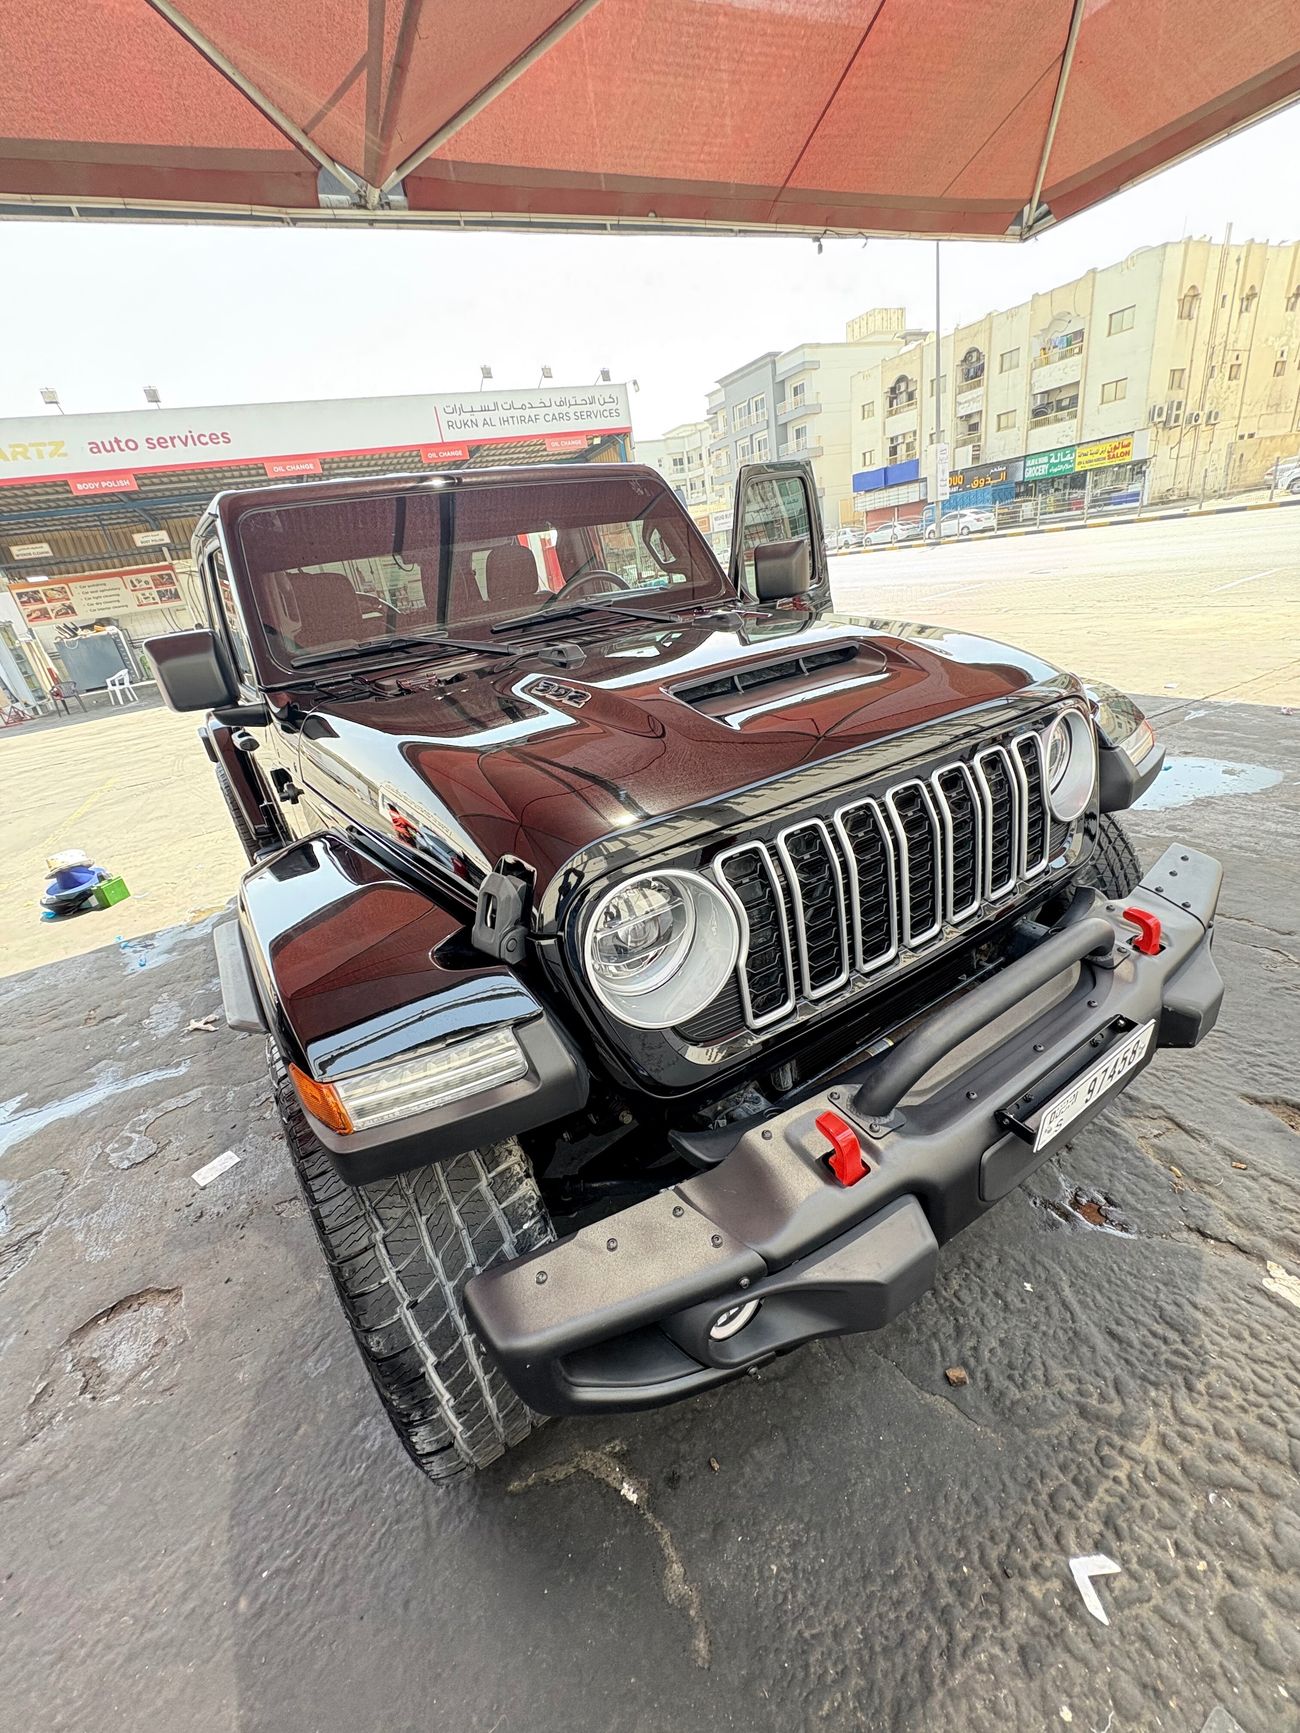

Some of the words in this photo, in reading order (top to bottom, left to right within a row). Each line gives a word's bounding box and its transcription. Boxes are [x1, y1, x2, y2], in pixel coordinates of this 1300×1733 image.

[501, 398, 553, 411] لخدمات
[554, 395, 596, 408] الاحتراف
[597, 393, 619, 406] ركن
[443, 401, 499, 416] السيارات
[446, 418, 479, 431] RUKN
[482, 417, 496, 428] AL
[498, 413, 540, 427] IHTIRAF
[543, 411, 571, 424] CARS
[573, 408, 621, 420] SERVICES
[87, 436, 139, 454] auto
[145, 430, 232, 450] services
[439, 450, 463, 458] CHANGE
[1107, 450, 1131, 460] SALON
[286, 463, 314, 471] CHANGE
[1025, 464, 1049, 478] GROCERY
[76, 482, 99, 490] BODY
[101, 480, 130, 488] POLISH
[531, 680, 592, 709] 392
[1085, 1040, 1140, 1103] 97458
